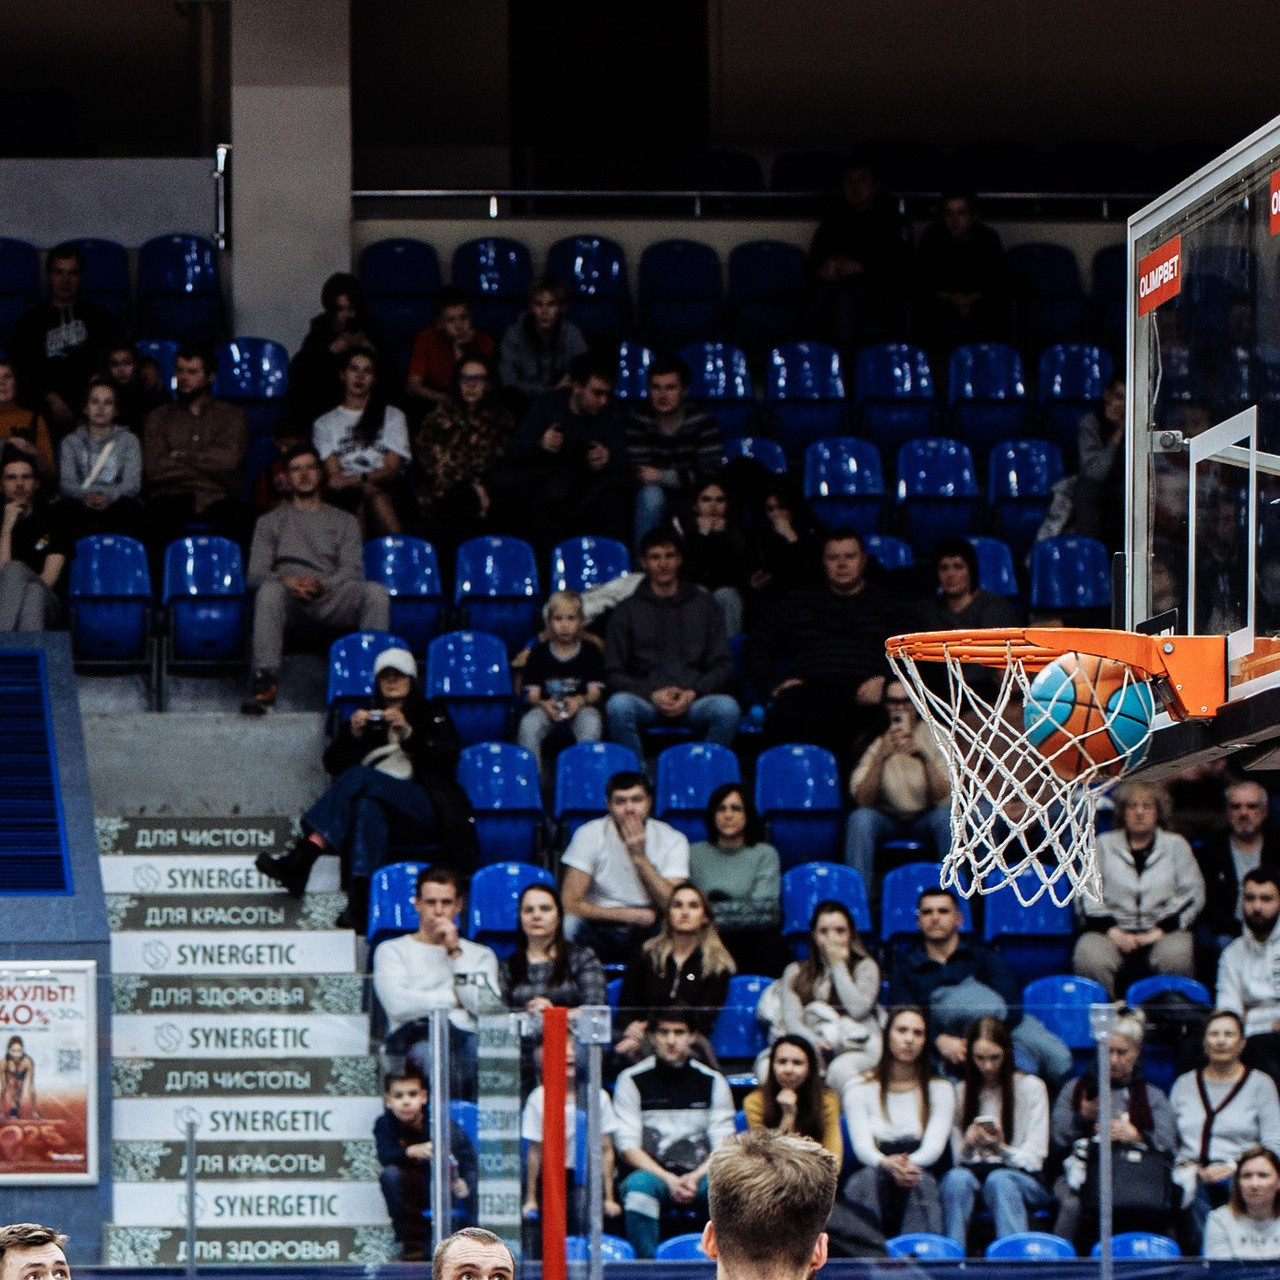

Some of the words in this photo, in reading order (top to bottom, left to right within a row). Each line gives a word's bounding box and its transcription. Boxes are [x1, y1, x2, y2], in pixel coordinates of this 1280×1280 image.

[1140, 254, 1179, 298] OLIMPBET
[136, 829, 177, 849] ДЛЯ
[181, 828, 275, 847] ЧИСТОТЫ
[145, 907, 187, 927] ДЛЯ
[192, 906, 285, 925] КРАСОТЫ
[177, 944, 295, 966] SYNERGETIC
[149, 987, 192, 1007] ДЛЯ
[196, 986, 305, 1006] ЗДОРОВЬЯ
[190, 1027, 309, 1049] SYNERGETIC
[165, 1071, 209, 1091] ДЛЯ
[213, 1070, 311, 1090] ЧИСТОТЫ
[210, 1110, 332, 1132] SYNERGETIC
[227, 1153, 326, 1173] КРАСОТЫ
[214, 1194, 338, 1217] SYNERGETIC
[226, 1240, 339, 1261] ЗДОРОВЬЯ
